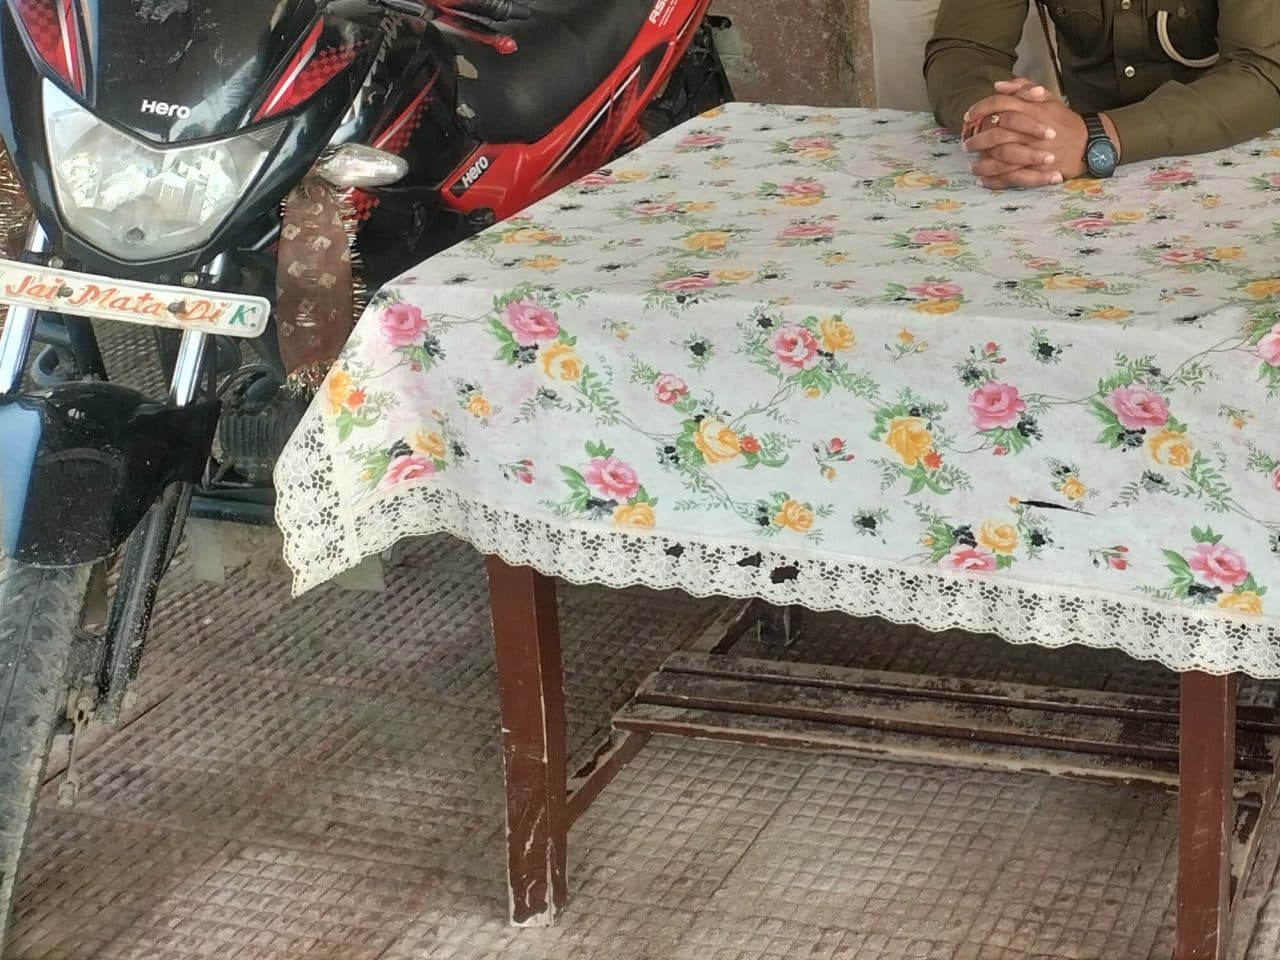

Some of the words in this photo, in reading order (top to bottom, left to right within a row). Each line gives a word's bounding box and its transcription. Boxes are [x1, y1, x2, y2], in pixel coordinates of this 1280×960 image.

[141, 99, 191, 119] Hero
[461, 155, 489, 188] Hero
[5, 275, 61, 301] Jai
[69, 284, 162, 316] Mata
[177, 300, 232, 324] Di
